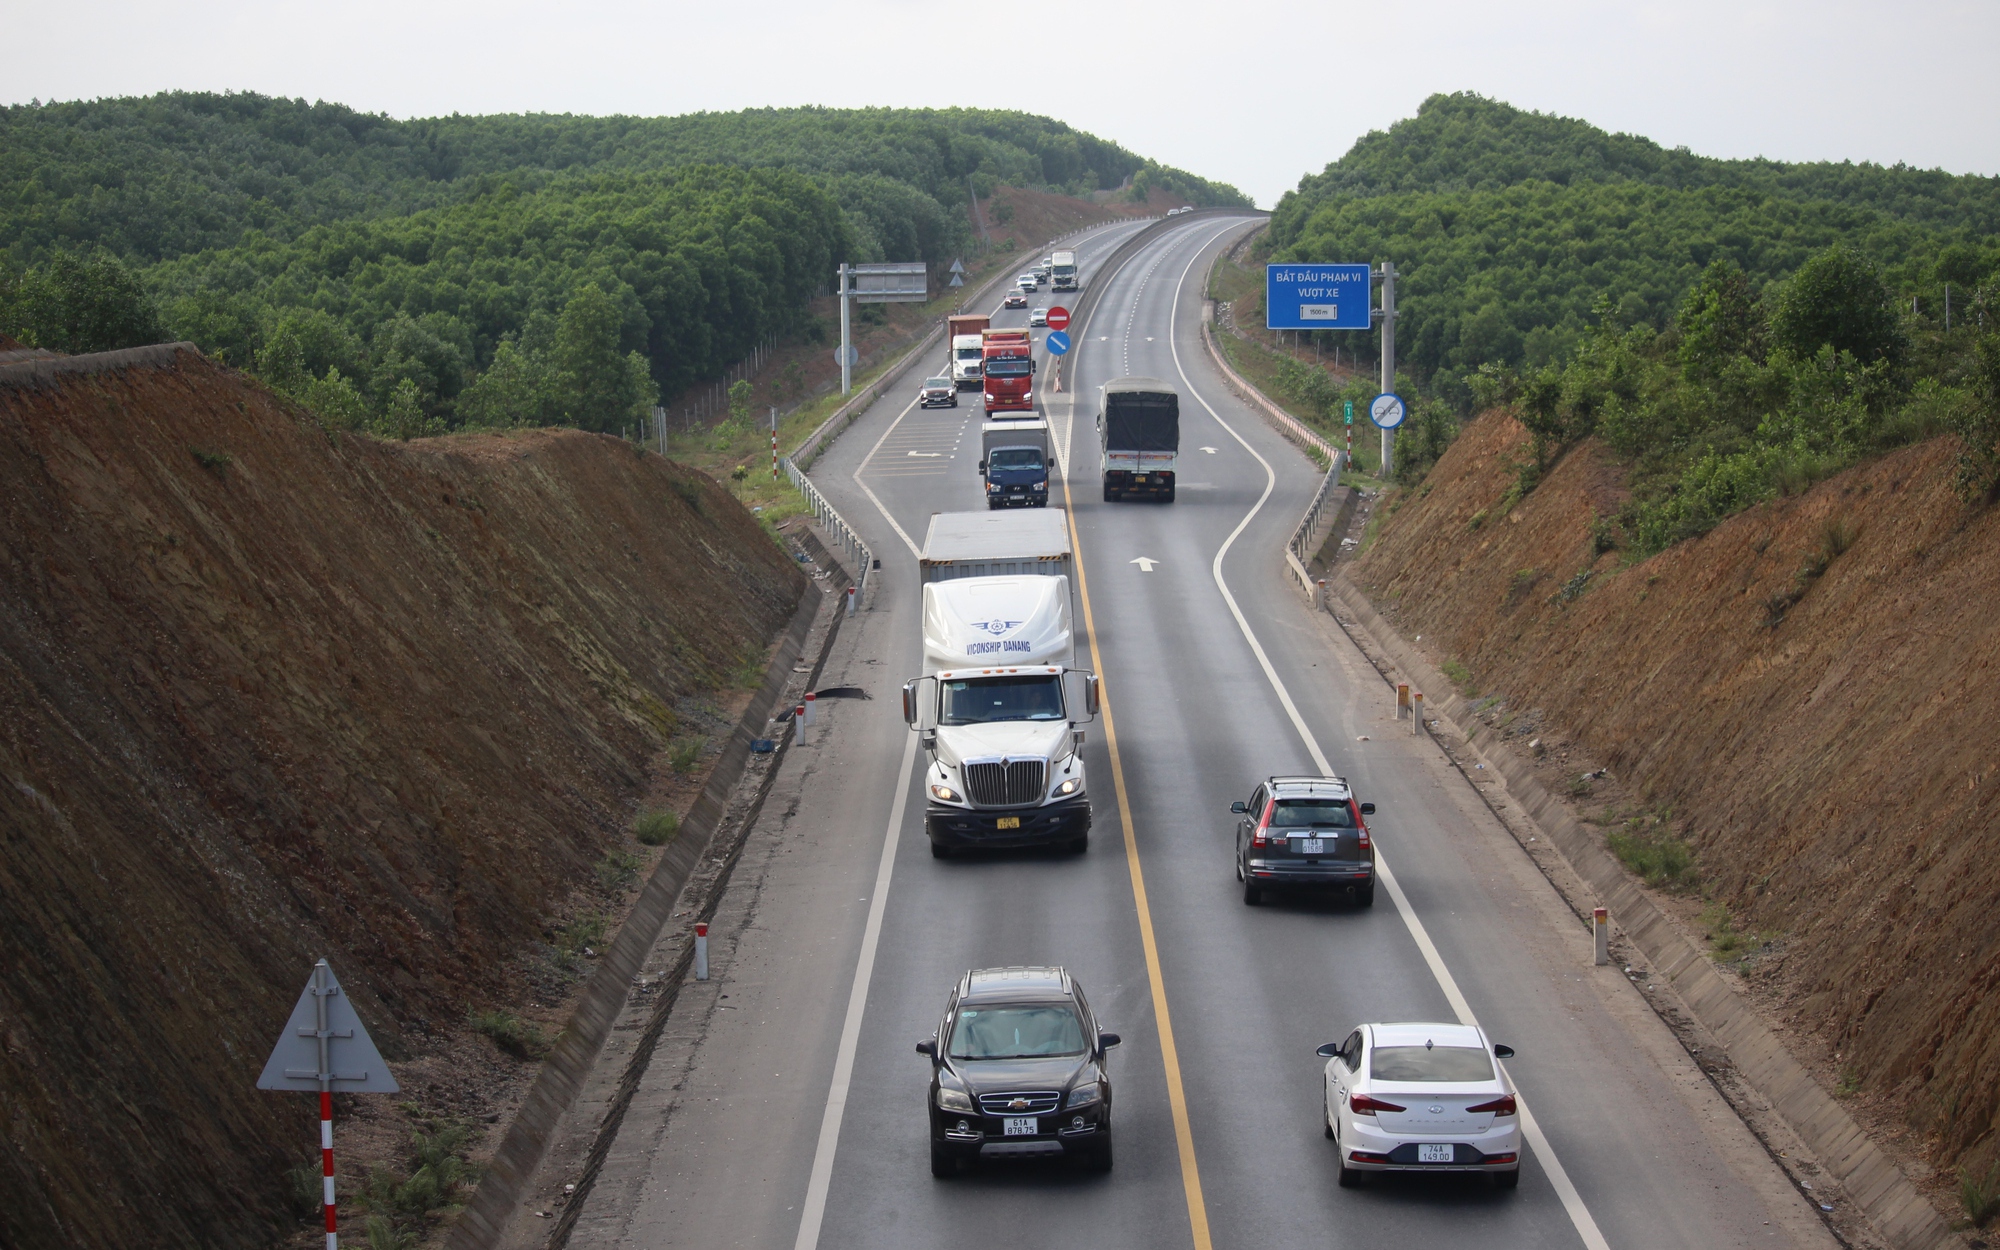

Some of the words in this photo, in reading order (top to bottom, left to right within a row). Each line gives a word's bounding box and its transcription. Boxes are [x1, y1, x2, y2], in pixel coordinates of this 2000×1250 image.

[1276, 269, 1295, 282] BẮT
[1297, 270, 1318, 282] ĐẦU
[1320, 273, 1349, 284] PHẠM
[1351, 273, 1361, 282] VI
[1298, 287, 1324, 299] VƯỢT
[1326, 288, 1339, 298] XE
[966, 641, 1002, 656] VICONSHIP
[1003, 640, 1031, 652] DANANG
[1013, 1119, 1028, 1127] 61A
[1007, 1126, 1035, 1135] 878.75
[1428, 1145, 1444, 1153] 74A
[1423, 1152, 1450, 1161] 149.00
